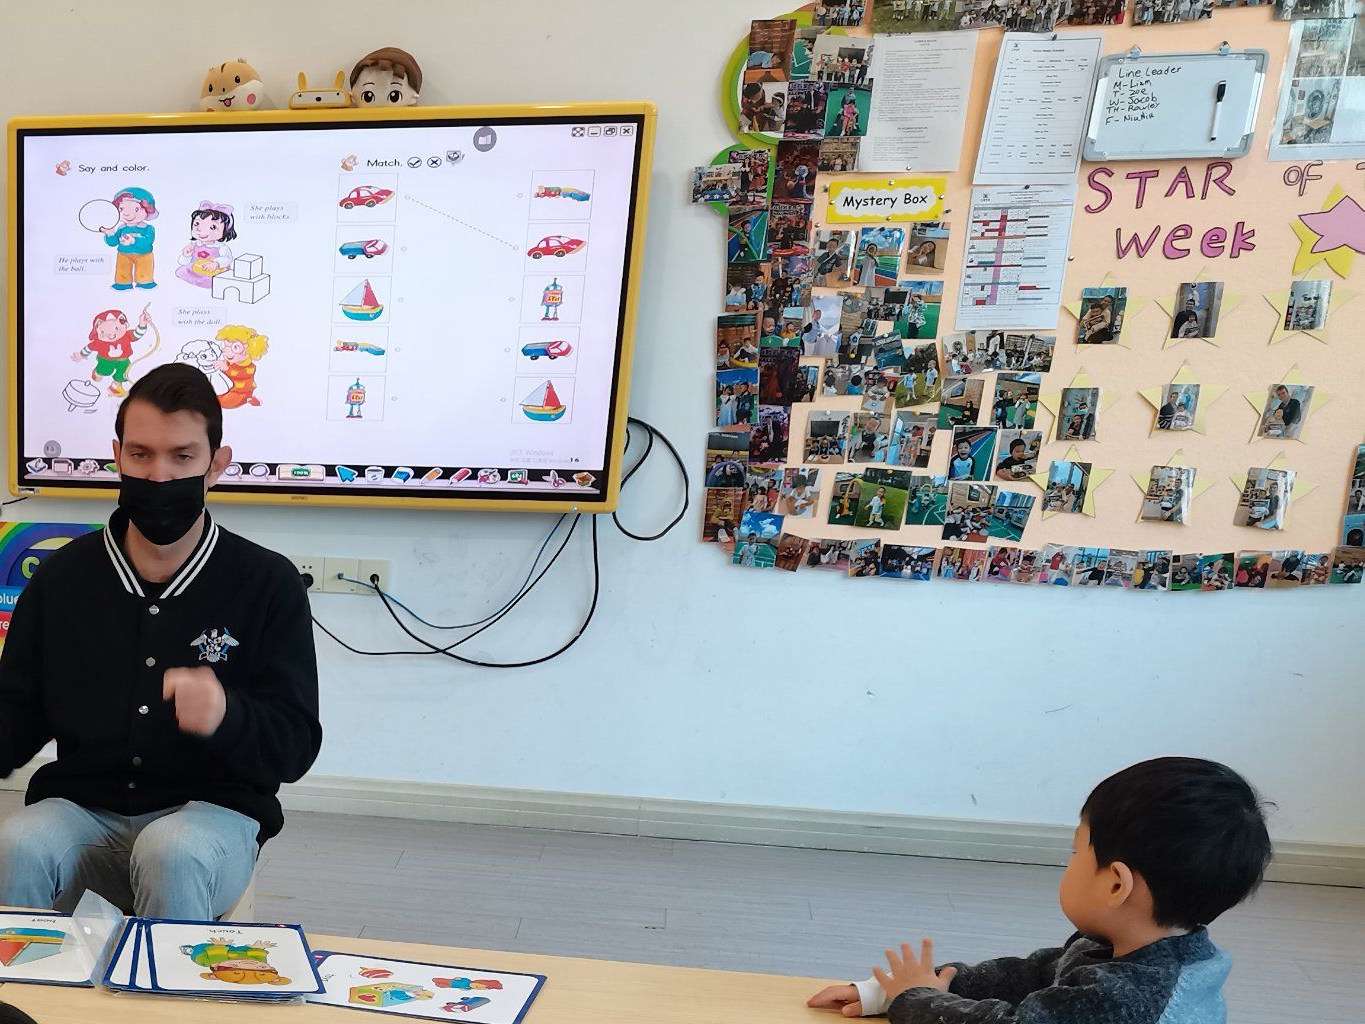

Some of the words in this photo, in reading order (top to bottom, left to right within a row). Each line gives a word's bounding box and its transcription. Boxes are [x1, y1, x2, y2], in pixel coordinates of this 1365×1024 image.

[1119, 68, 1142, 78] Line
[1145, 66, 1182, 77] Leader
[78, 164, 96, 174] Say
[100, 164, 118, 172] and
[122, 163, 150, 172] color.
[366, 157, 403, 168] Match.
[1084, 161, 1236, 214] STAR
[842, 195, 898, 210] Mystery
[903, 192, 928, 205] Box
